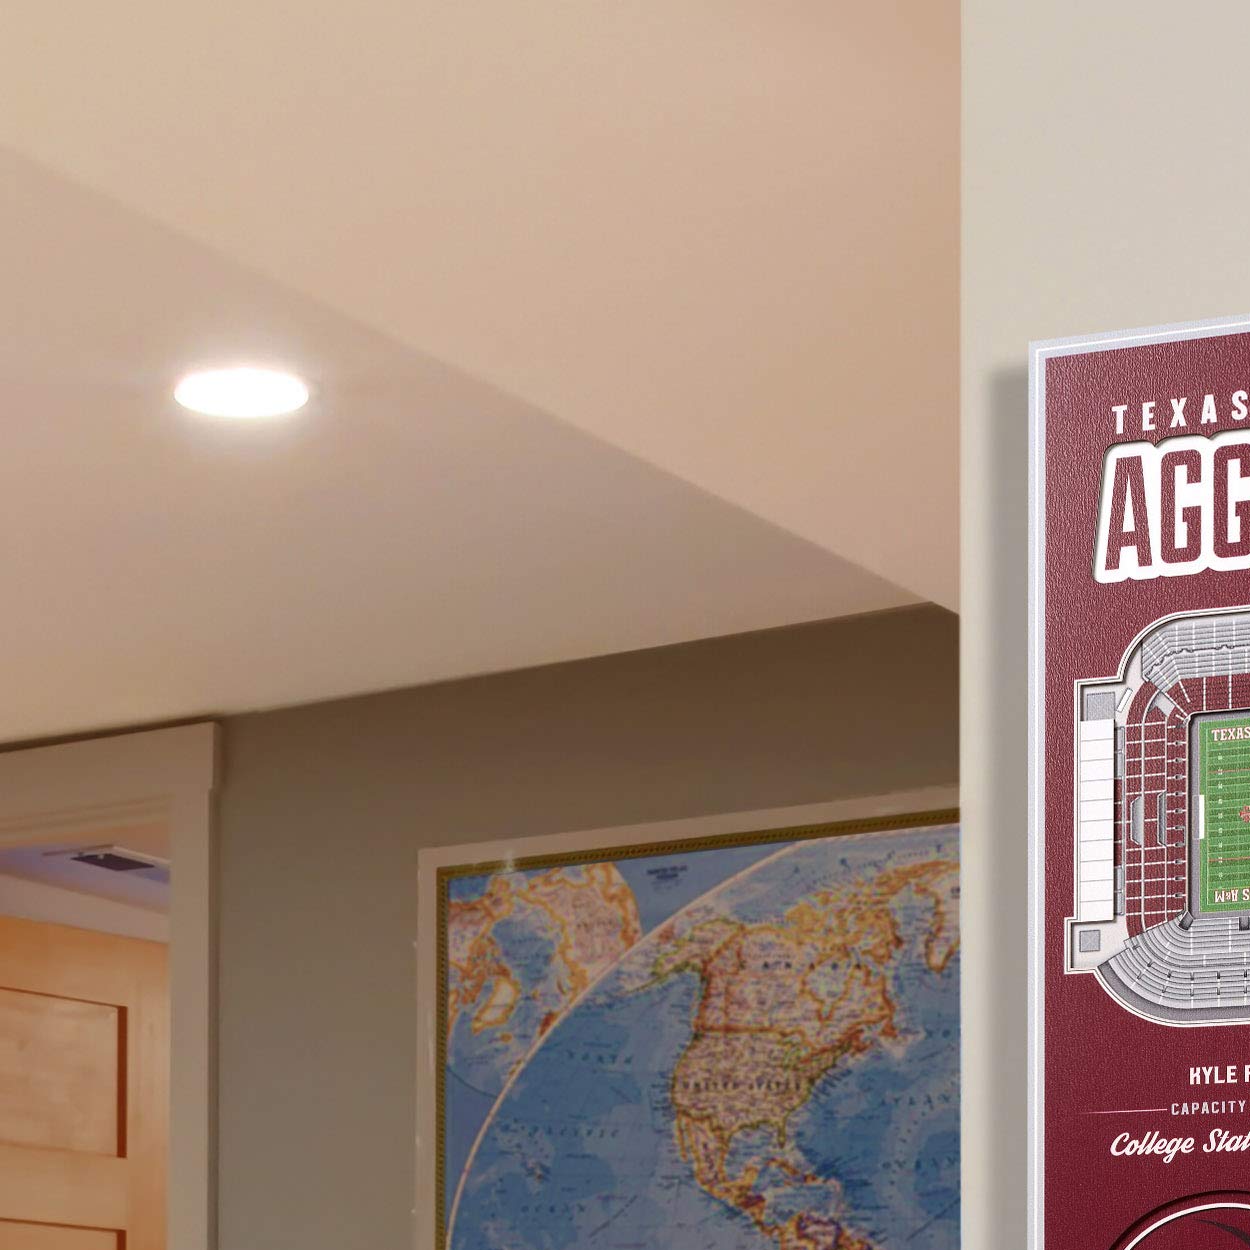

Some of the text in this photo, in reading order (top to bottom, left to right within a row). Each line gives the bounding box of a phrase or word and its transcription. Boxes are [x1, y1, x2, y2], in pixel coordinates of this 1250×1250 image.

[1112, 390, 1249, 435] TEXAS
[1190, 1066, 1238, 1085] KYLE
[1171, 1100, 1246, 1116] CAPACITY
[1110, 1131, 1195, 1164] College
